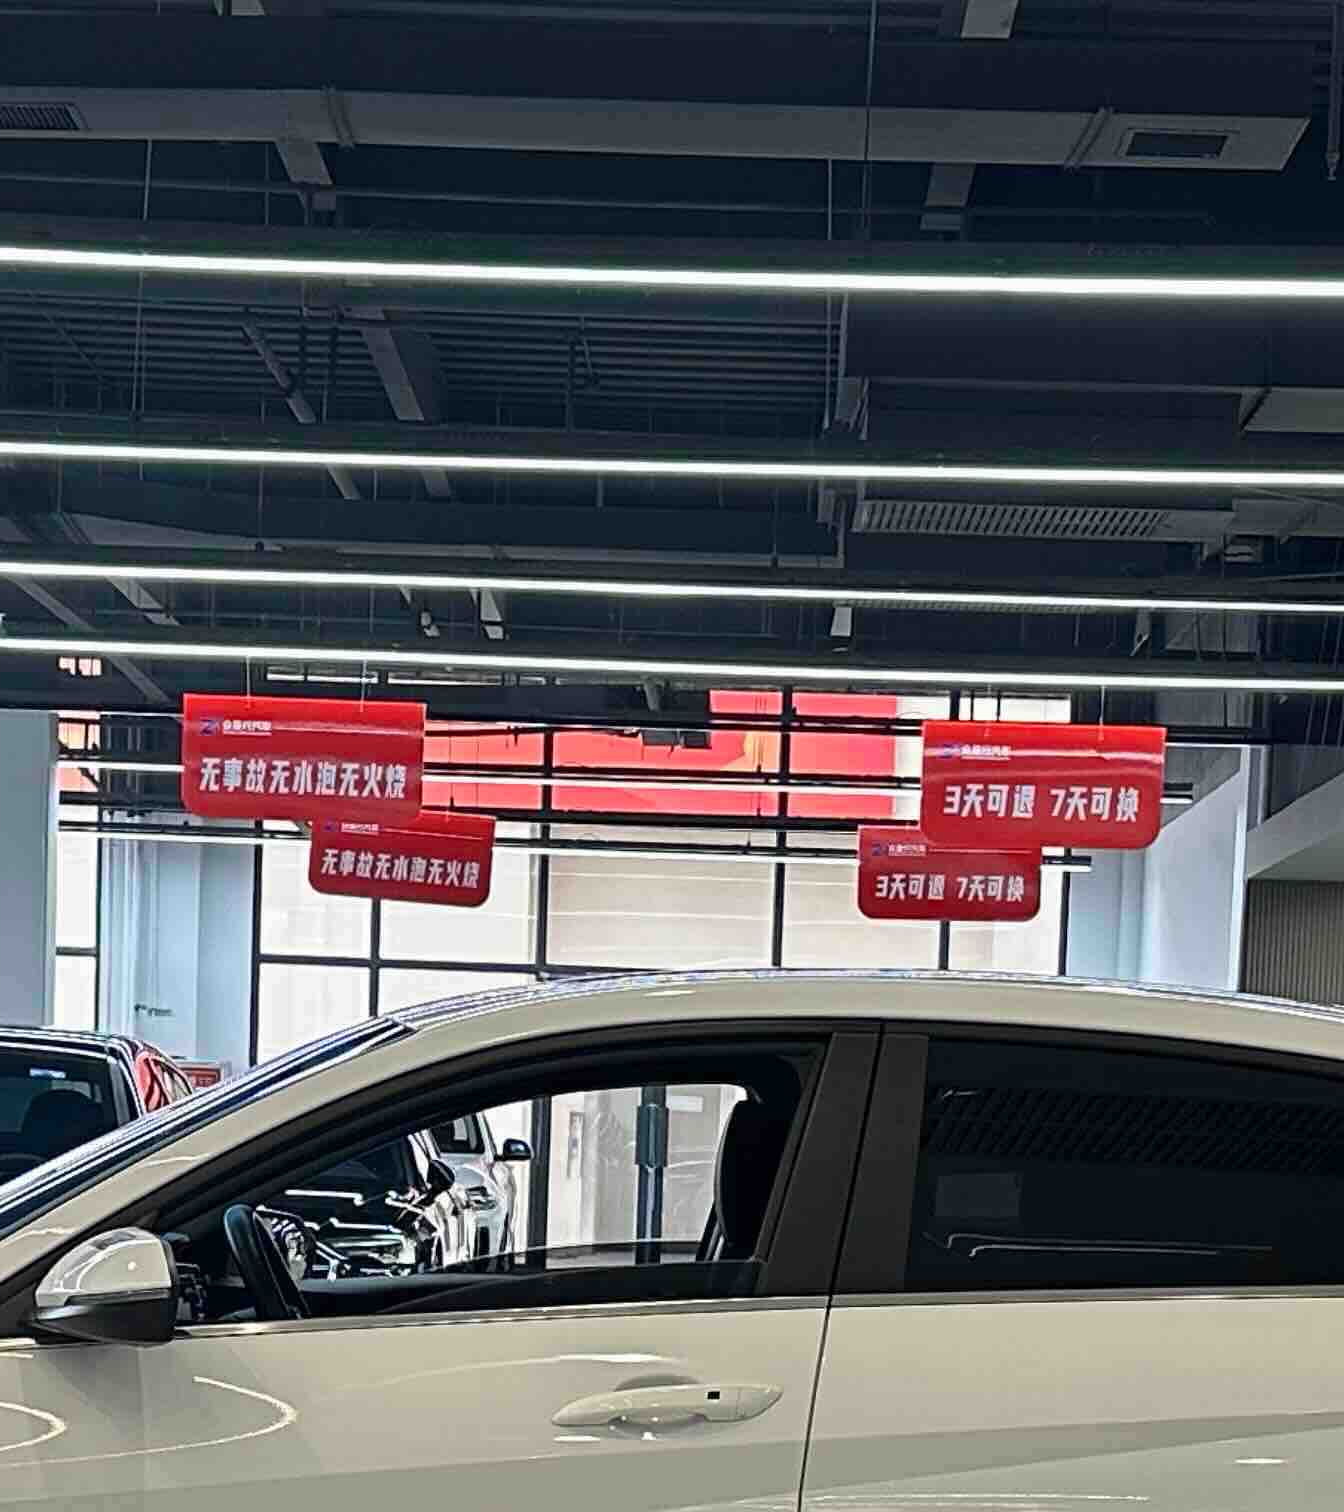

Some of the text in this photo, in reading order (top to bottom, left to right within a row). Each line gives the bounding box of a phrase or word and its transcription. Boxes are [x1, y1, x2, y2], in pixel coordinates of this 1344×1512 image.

[199, 757, 406, 800] 无事故无水泡无火烧
[943, 783, 1140, 823] 3天可退 7天可换
[320, 848, 481, 889] 无事故无水泡无火烧
[874, 872, 1025, 903] 3天可退 7天可换
